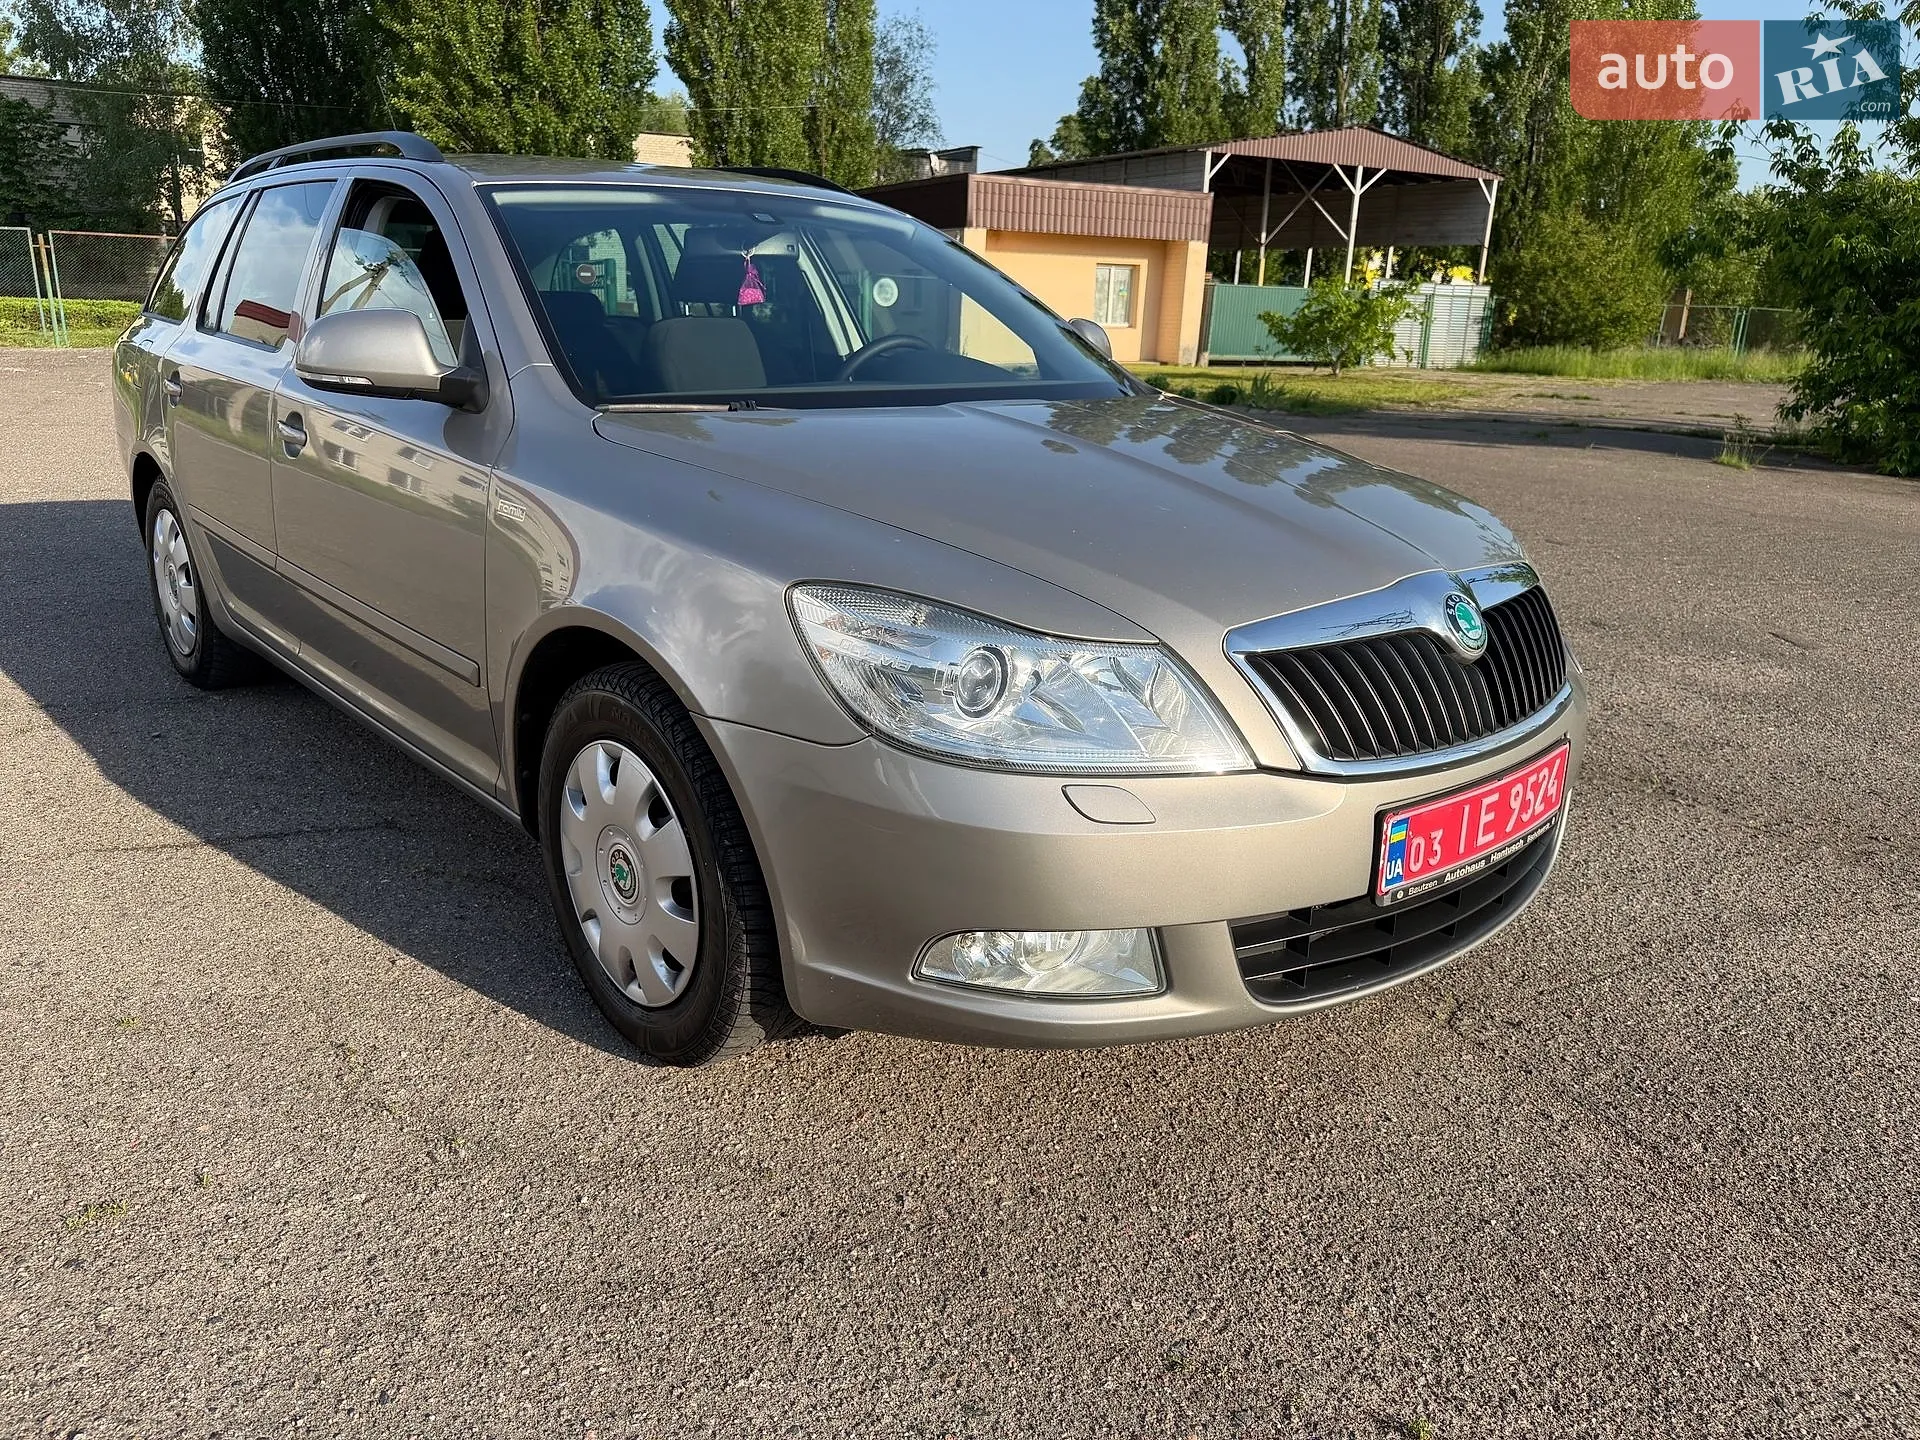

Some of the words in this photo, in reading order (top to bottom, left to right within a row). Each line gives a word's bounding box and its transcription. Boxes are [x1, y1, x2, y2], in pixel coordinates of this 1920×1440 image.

[1409, 829, 1444, 873] 03
[1458, 792, 1499, 855] IE
[1505, 757, 1562, 833] 9524
[1386, 859, 1403, 880] UA
[1408, 879, 1438, 896] Bautzen
[1443, 859, 1486, 883] Autohaus
